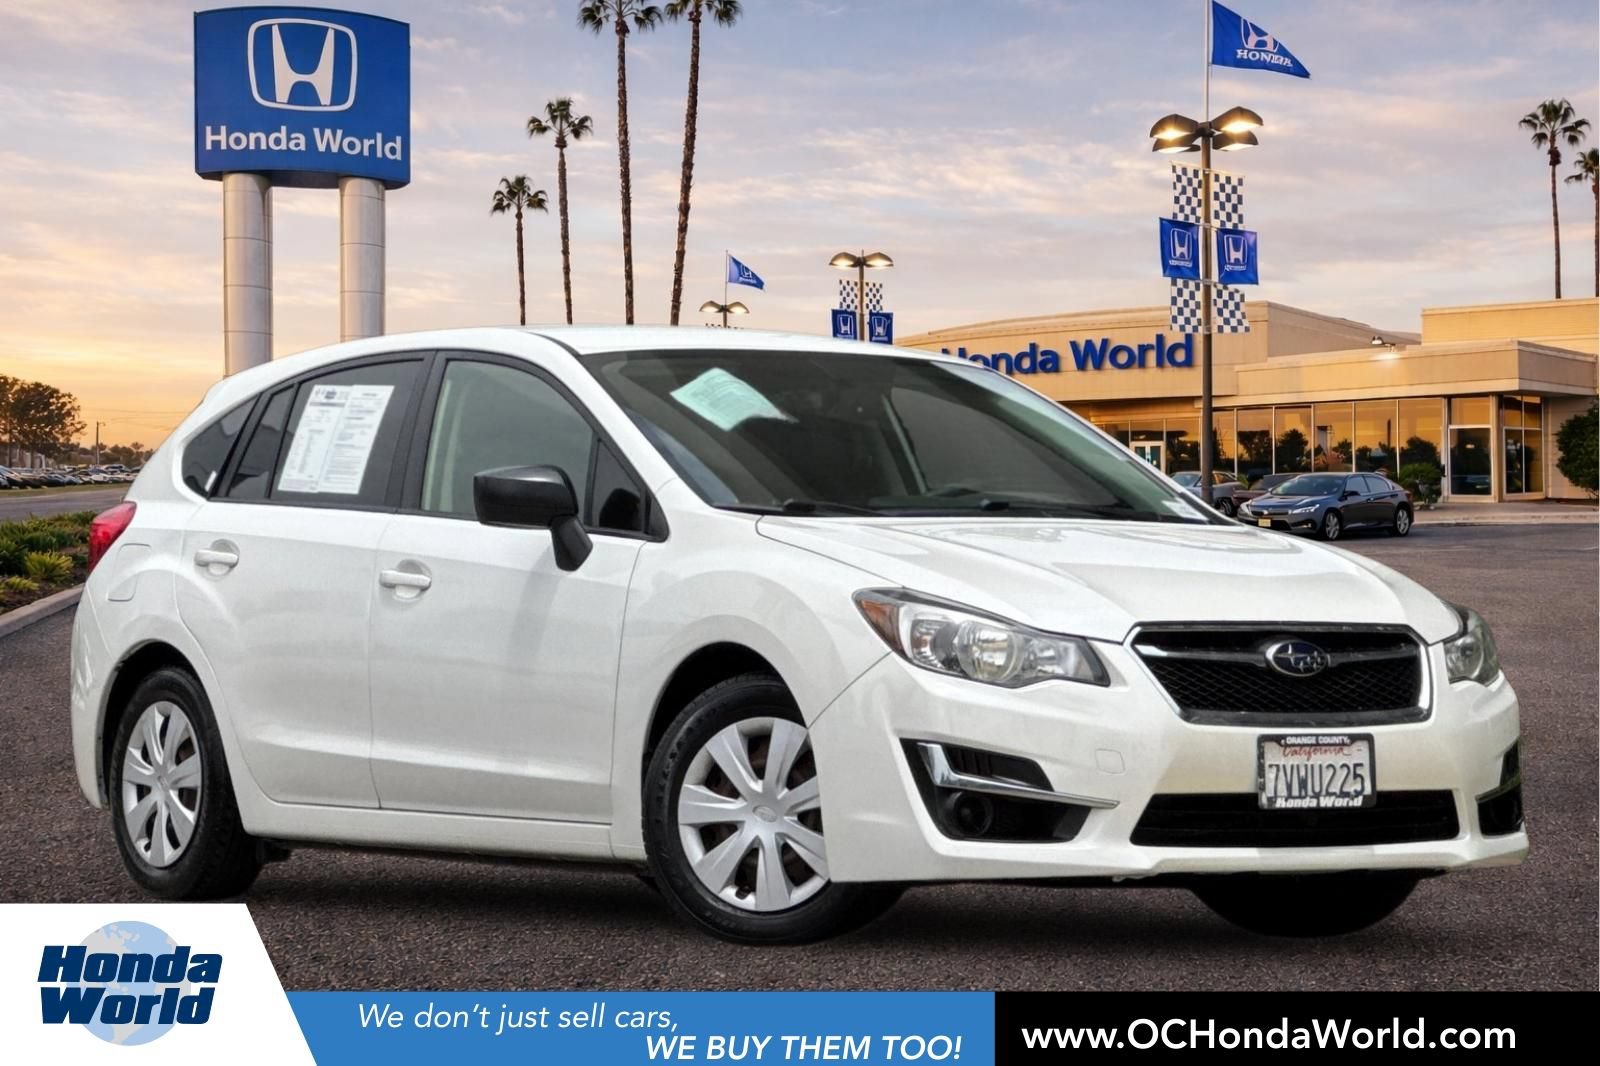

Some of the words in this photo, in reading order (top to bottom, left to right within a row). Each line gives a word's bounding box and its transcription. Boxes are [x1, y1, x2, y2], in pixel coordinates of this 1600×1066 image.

[205, 125, 306, 151] Honda
[313, 127, 402, 161] World
[941, 342, 1060, 376] onda
[1070, 333, 1194, 371] World
[1286, 735, 1317, 745] ORANGE
[1319, 735, 1349, 744] COUNTY
[1268, 763, 1365, 798] 7VWU225
[1275, 796, 1318, 809] Honda
[1319, 795, 1363, 808] World
